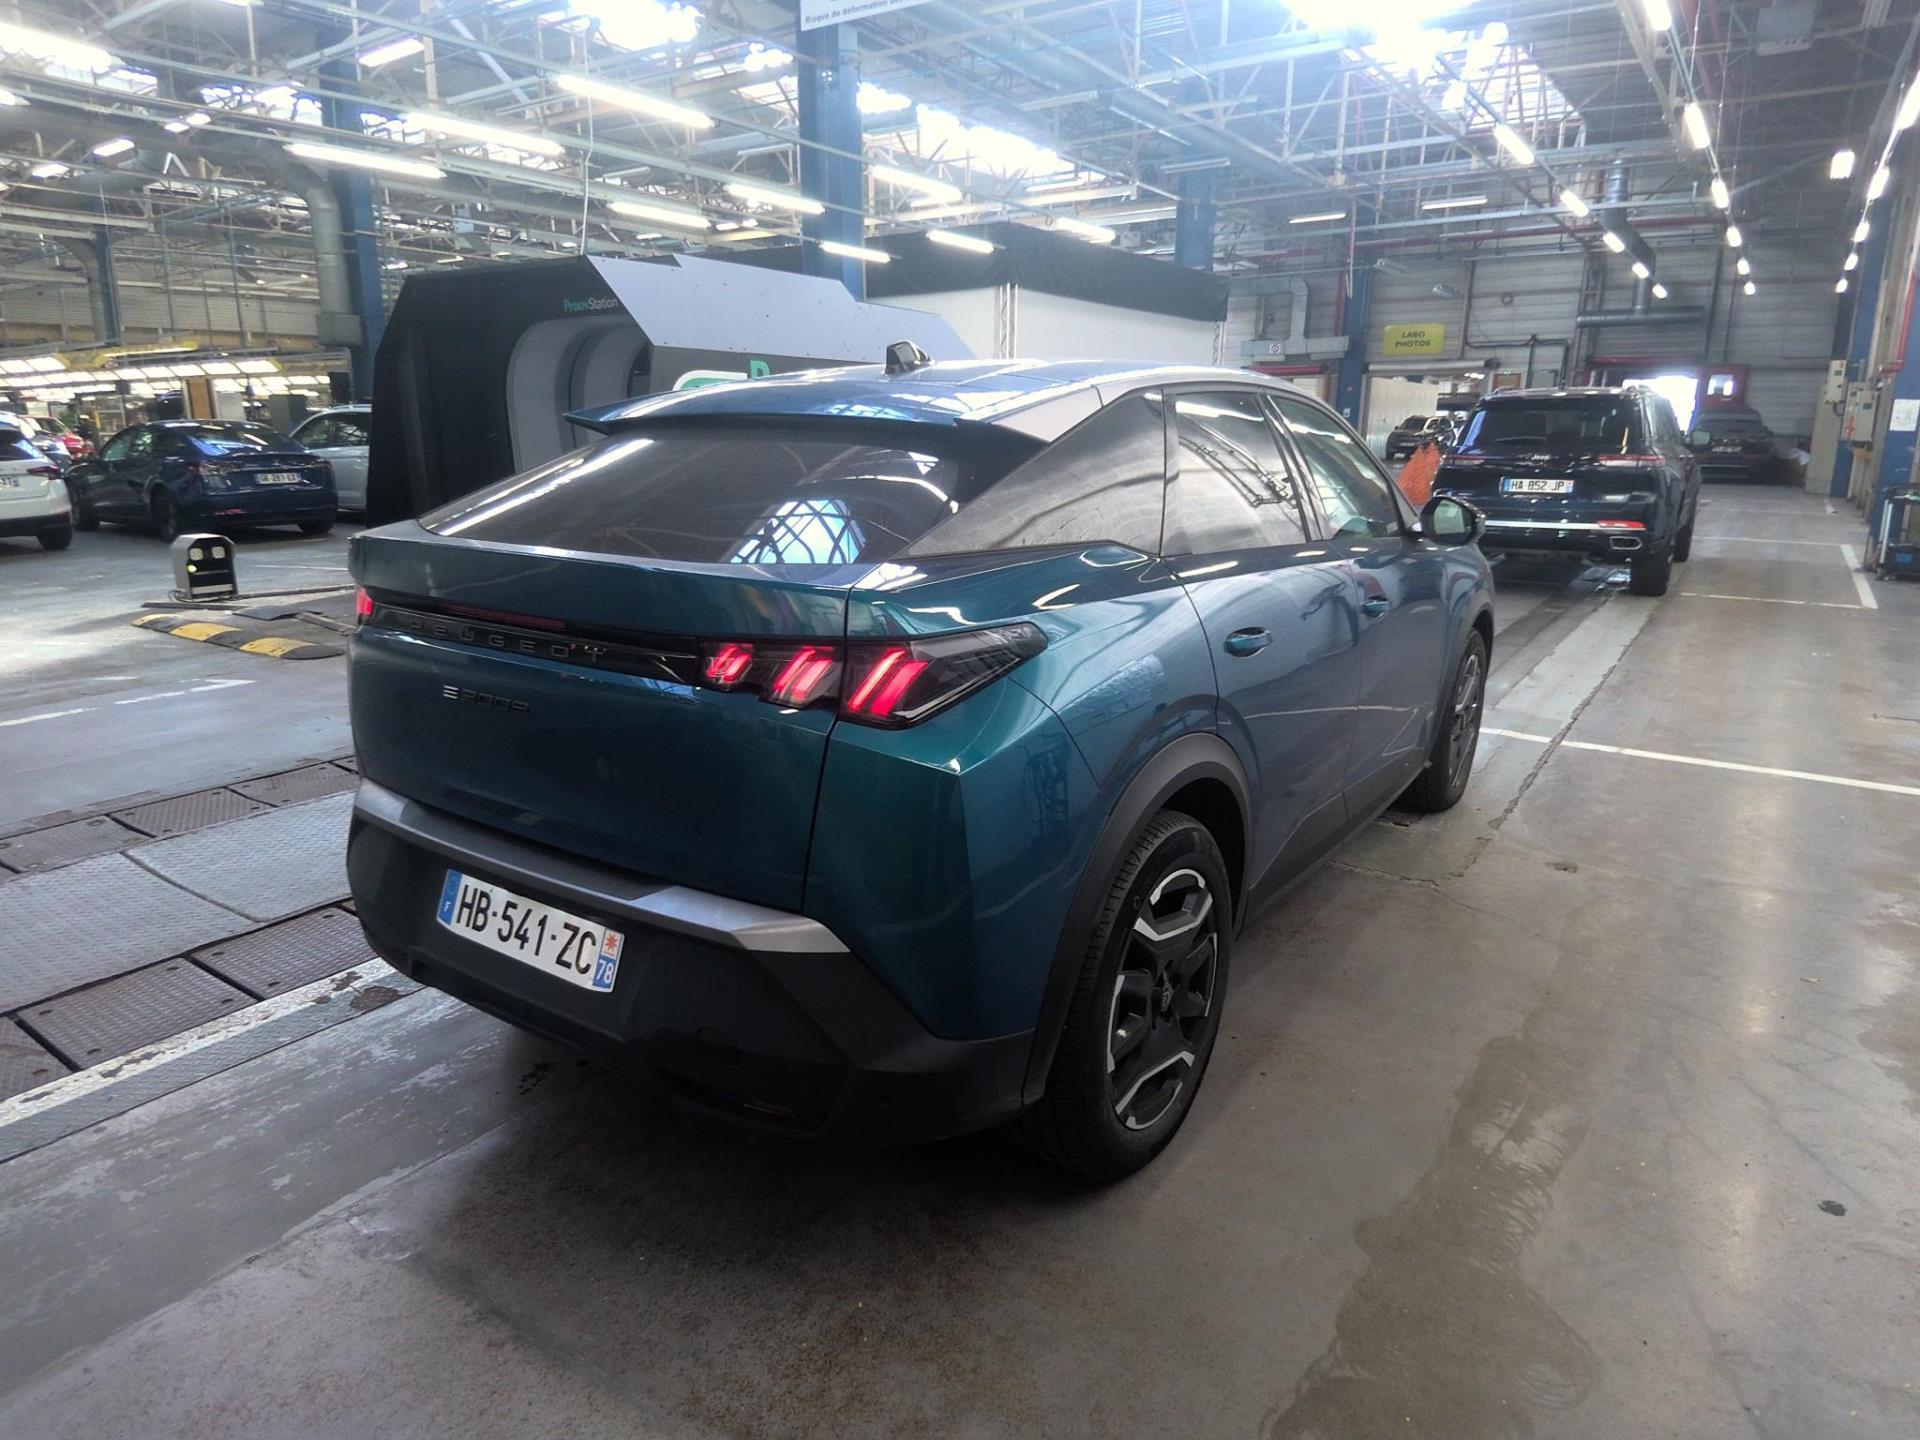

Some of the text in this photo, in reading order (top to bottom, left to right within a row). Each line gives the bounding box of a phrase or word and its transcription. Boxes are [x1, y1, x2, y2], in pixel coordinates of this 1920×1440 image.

[805, 13, 829, 23] Risque
[831, 9, 842, 18] de
[1401, 331, 1426, 339] LABO
[1394, 340, 1431, 348] PHOTOS
[1531, 453, 1550, 461] Jeep
[1527, 481, 1548, 491] 852
[408, 619, 606, 663] PEUGEOT
[456, 884, 596, 975] HB-541-ZC
[596, 958, 614, 984] 78
